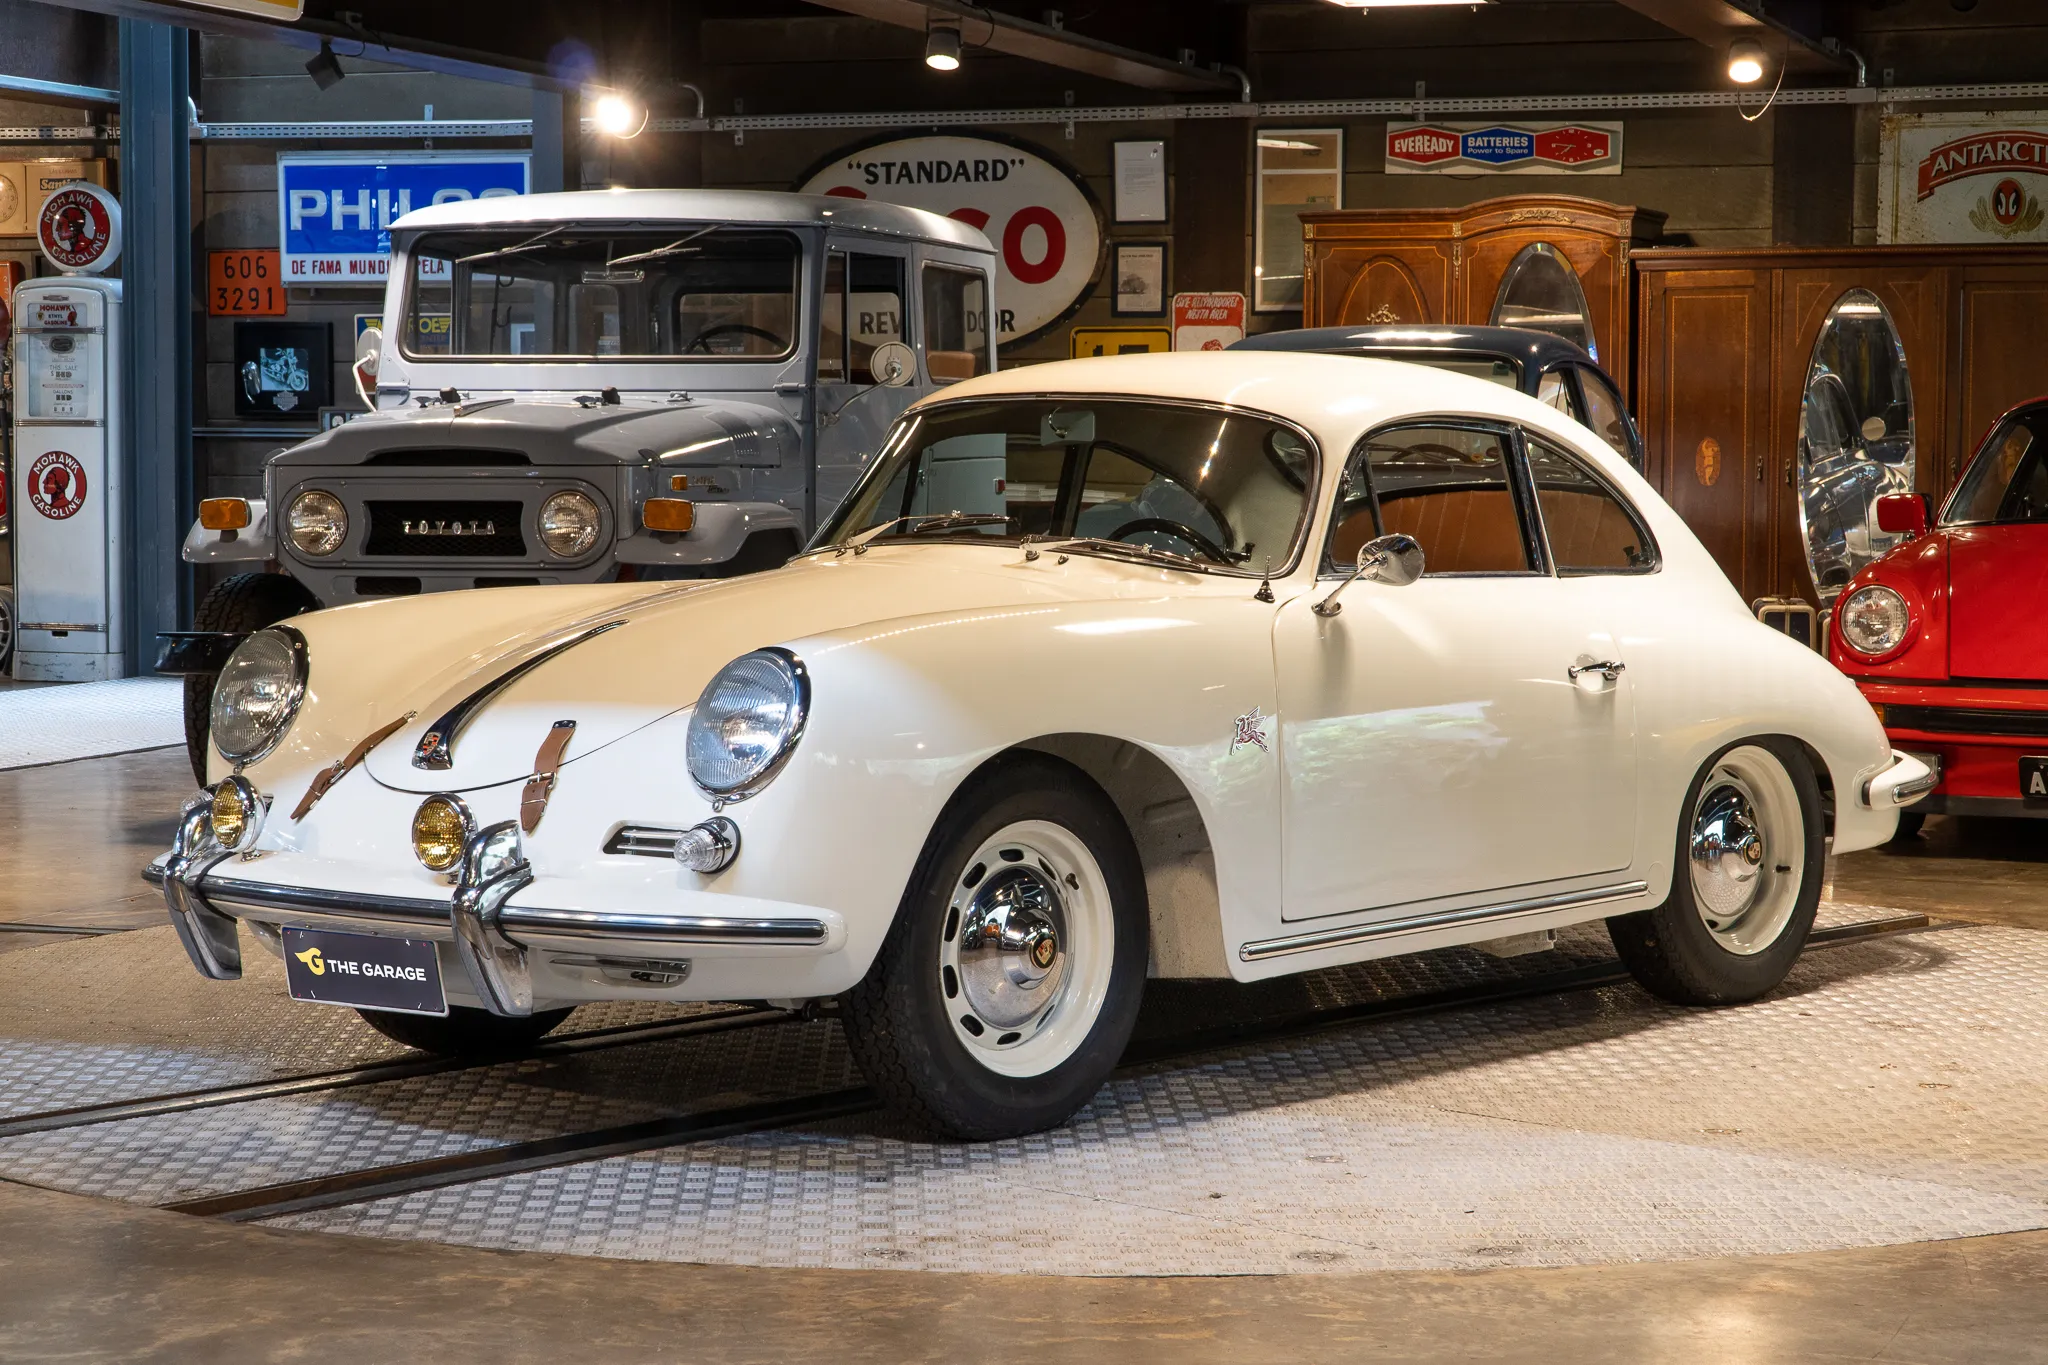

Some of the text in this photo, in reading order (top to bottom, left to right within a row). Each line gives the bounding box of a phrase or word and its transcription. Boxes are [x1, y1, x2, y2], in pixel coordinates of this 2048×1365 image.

[1394, 135, 1454, 153] EVEREADY
[1467, 136, 1528, 147] BATTERIES
[1505, 147, 1528, 155] Spare
[44, 193, 94, 223] MOHAWK
[52, 232, 106, 264] GASOLINE
[224, 256, 267, 279] 606
[291, 259, 307, 275] DE
[312, 259, 342, 275] FAMA
[216, 287, 273, 311] 3291
[33, 453, 79, 475] MOHAWK
[32, 494, 82, 517] GASOLINE
[402, 520, 496, 535] TOYOTA
[327, 959, 360, 976] THE
[361, 962, 427, 982] GARAGE
